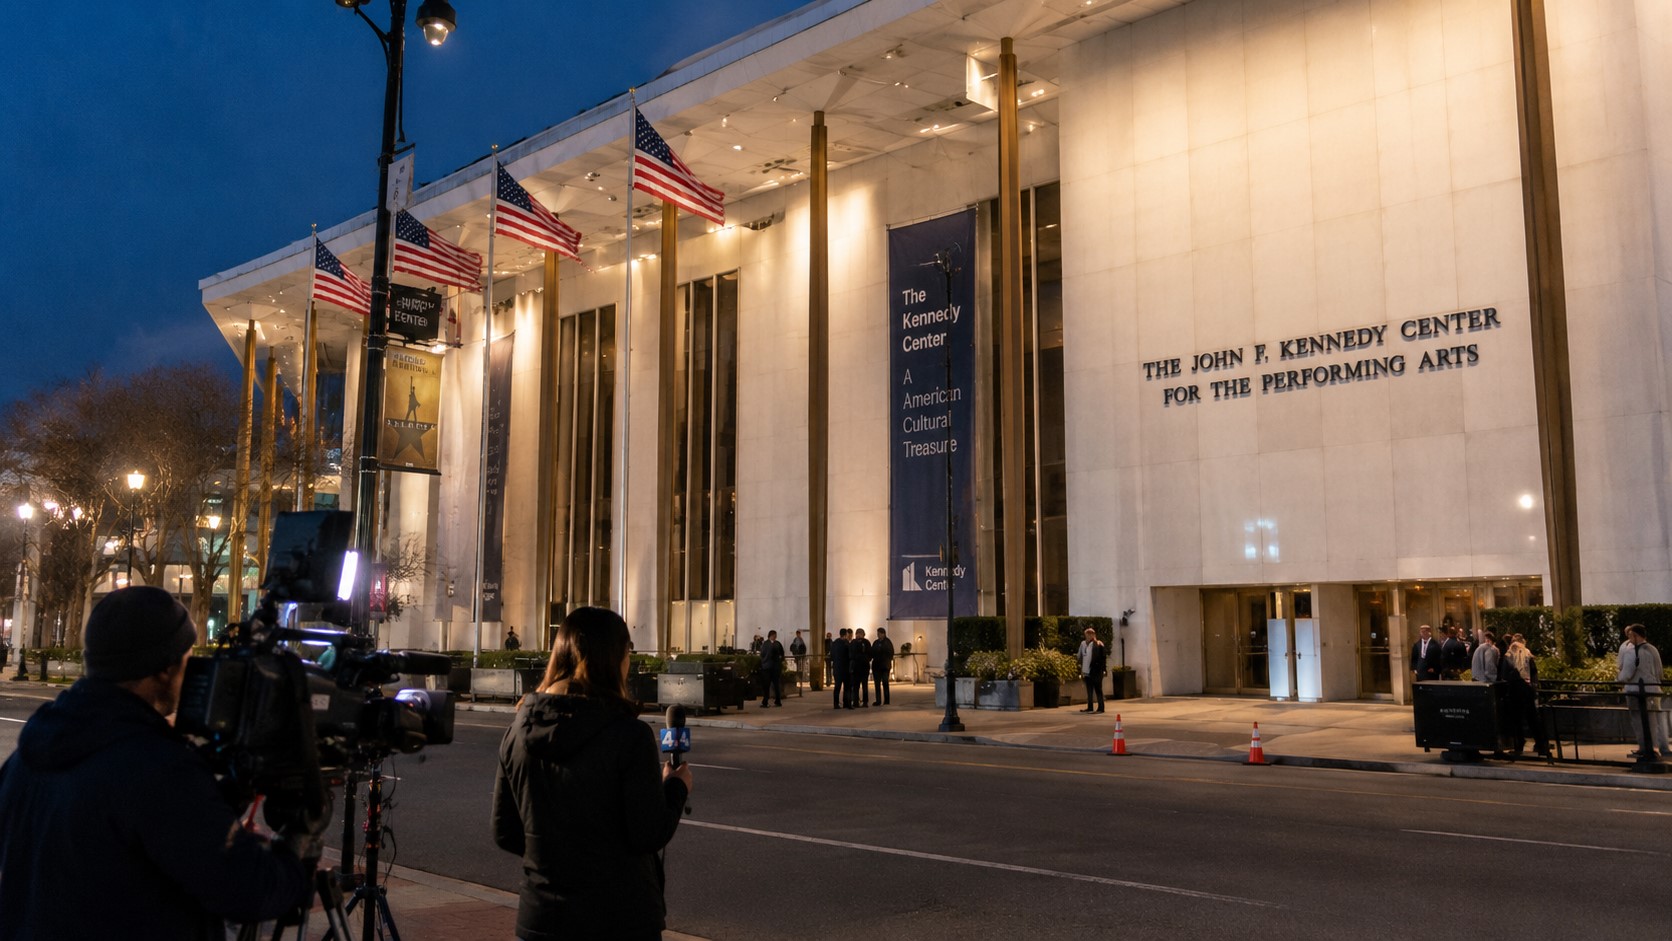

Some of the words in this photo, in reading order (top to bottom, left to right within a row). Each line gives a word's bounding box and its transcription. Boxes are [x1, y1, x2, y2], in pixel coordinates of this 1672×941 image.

[902, 288, 926, 305] The
[902, 304, 961, 329] Kennedy
[902, 332, 947, 352] Center
[1143, 358, 1182, 380] THE
[1191, 348, 1244, 373] JOHN
[1280, 325, 1388, 358] KENNEDY
[1400, 307, 1501, 338] CENTER
[902, 368, 913, 385] A
[1164, 385, 1201, 405] FOR
[1210, 377, 1251, 398] THE
[1262, 355, 1406, 393] PERFORMING
[1418, 344, 1479, 369] ARTS
[902, 386, 962, 409] American
[902, 410, 951, 433] Cultural
[902, 438, 958, 458] Treasure
[925, 564, 966, 579] Kenndy
[925, 580, 956, 590] Cent
[661, 731, 673, 748] 4
